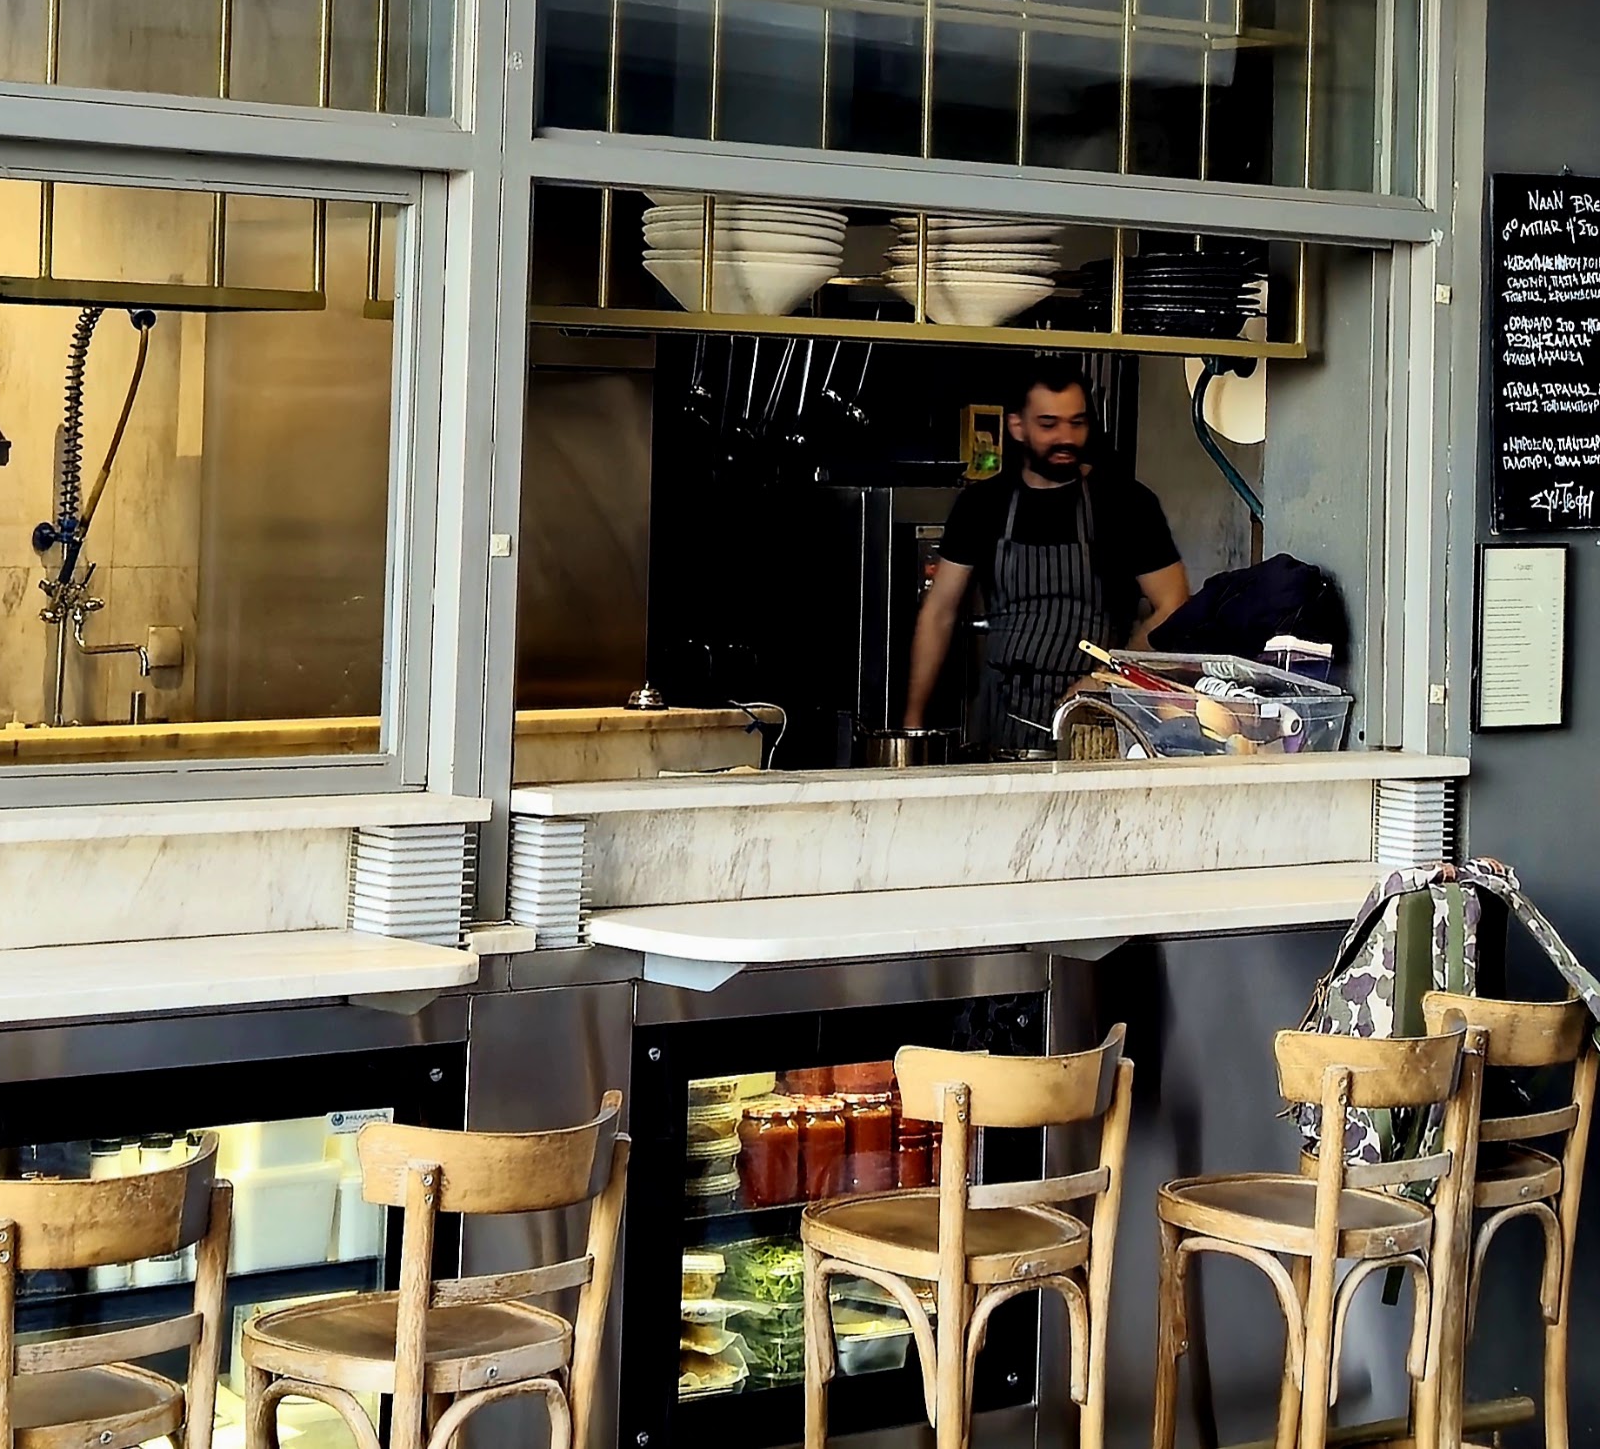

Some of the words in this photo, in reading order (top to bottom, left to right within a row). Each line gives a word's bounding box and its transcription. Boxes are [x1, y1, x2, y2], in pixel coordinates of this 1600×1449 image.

[1527, 189, 1563, 211] NAAN
[1556, 317, 1575, 332] ΣΤΟ
[1542, 333, 1592, 348] ΣΑΛΑΤΑ
